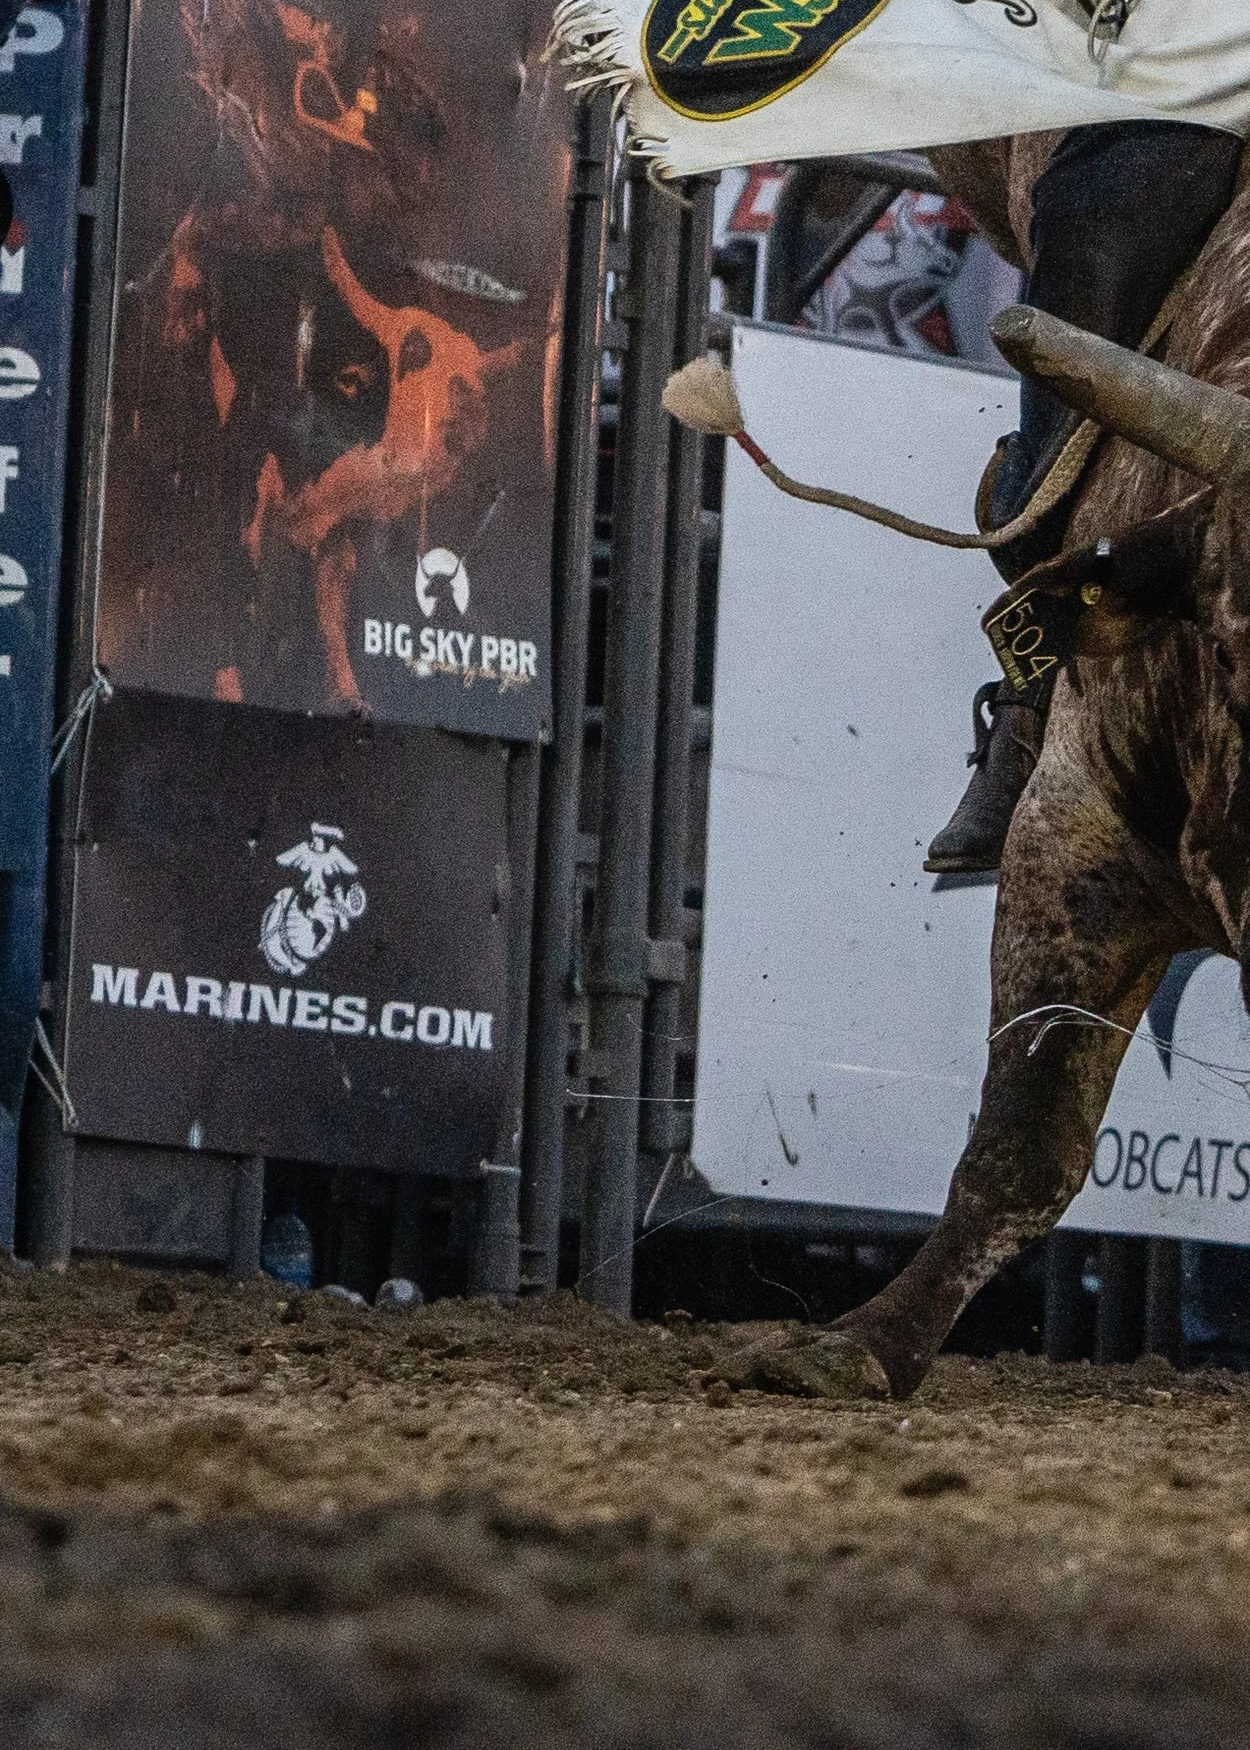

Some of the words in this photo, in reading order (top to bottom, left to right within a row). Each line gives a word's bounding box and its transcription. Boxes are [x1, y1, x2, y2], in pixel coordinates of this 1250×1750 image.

[364, 617, 414, 660] BIG
[419, 625, 475, 669] SKY
[481, 634, 538, 678] PBR
[1001, 601, 1058, 682] 504
[90, 962, 495, 1052] MARINES.COM
